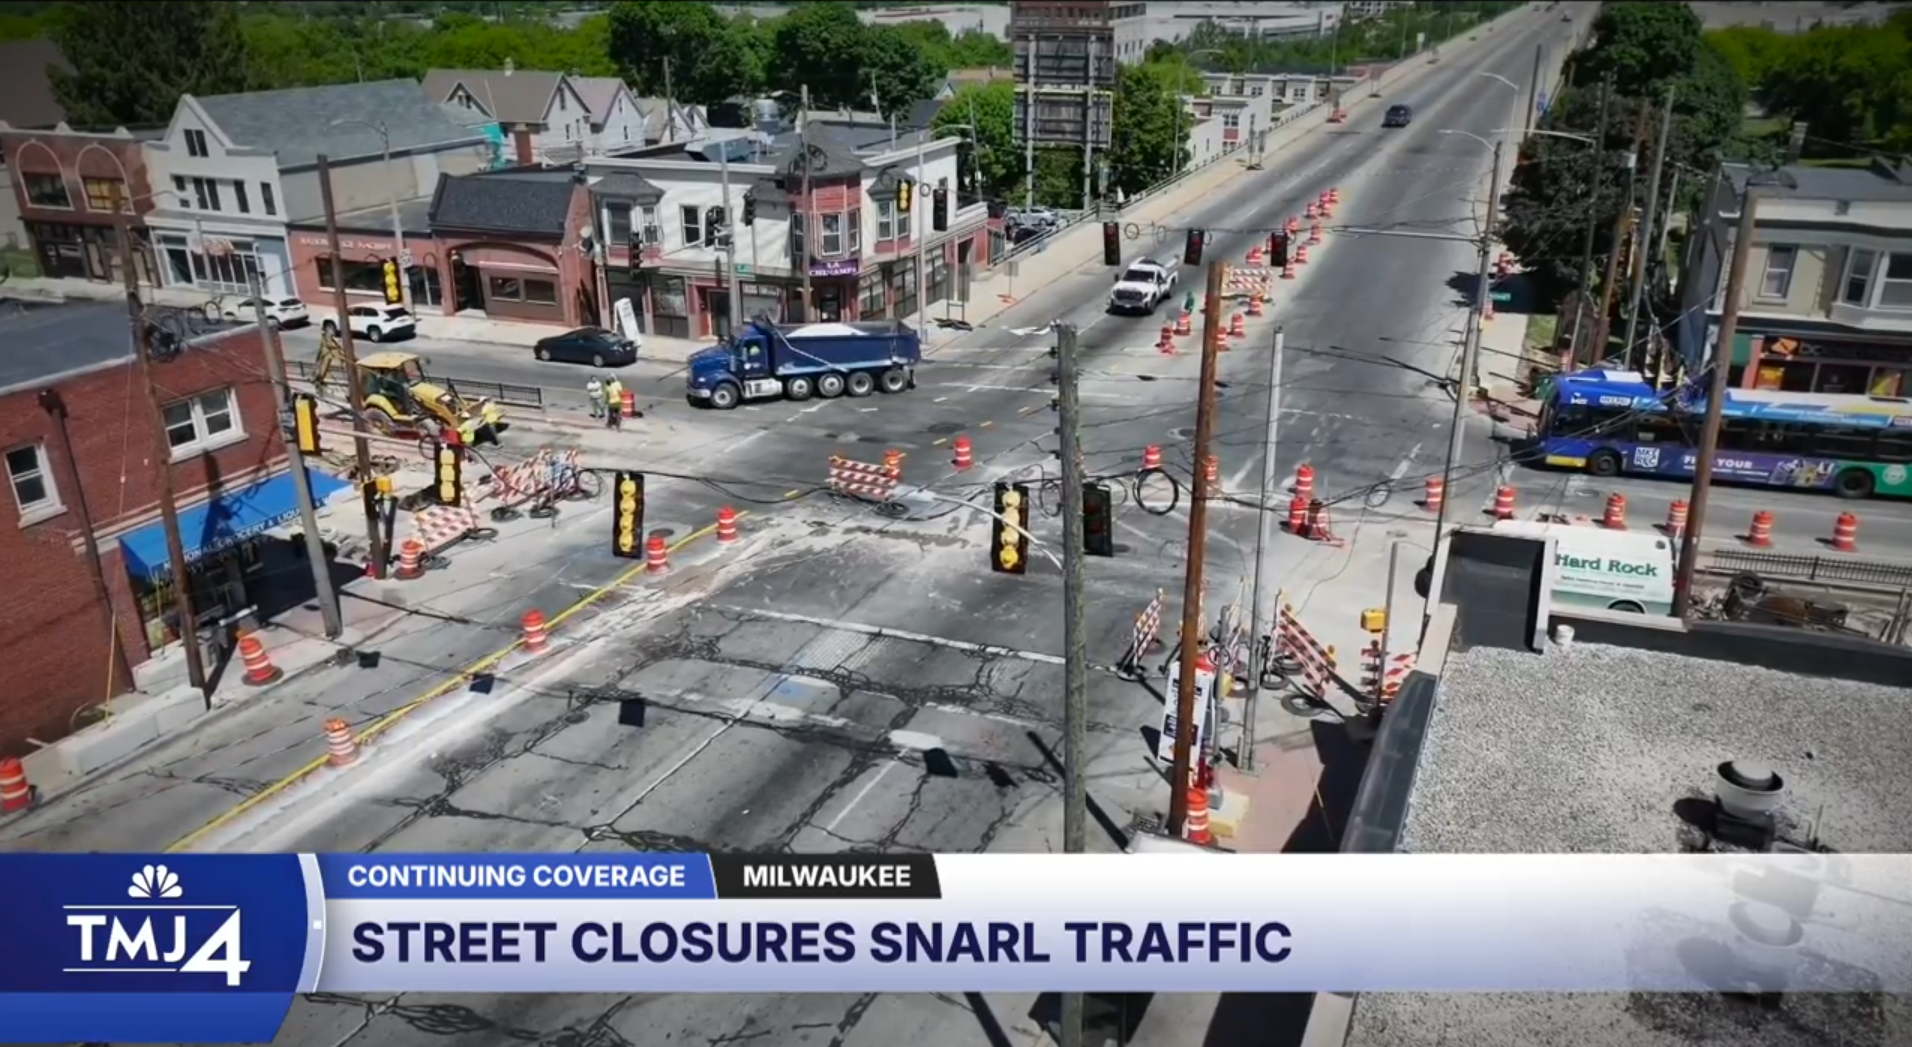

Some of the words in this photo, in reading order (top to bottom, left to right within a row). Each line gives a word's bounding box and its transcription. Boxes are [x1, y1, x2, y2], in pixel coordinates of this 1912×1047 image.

[1717, 458, 1753, 469] YOUR
[163, 543, 215, 570] NIONAL
[216, 521, 265, 547] GROCERY
[1554, 553, 1601, 570] Hard
[1607, 559, 1657, 577] Rock
